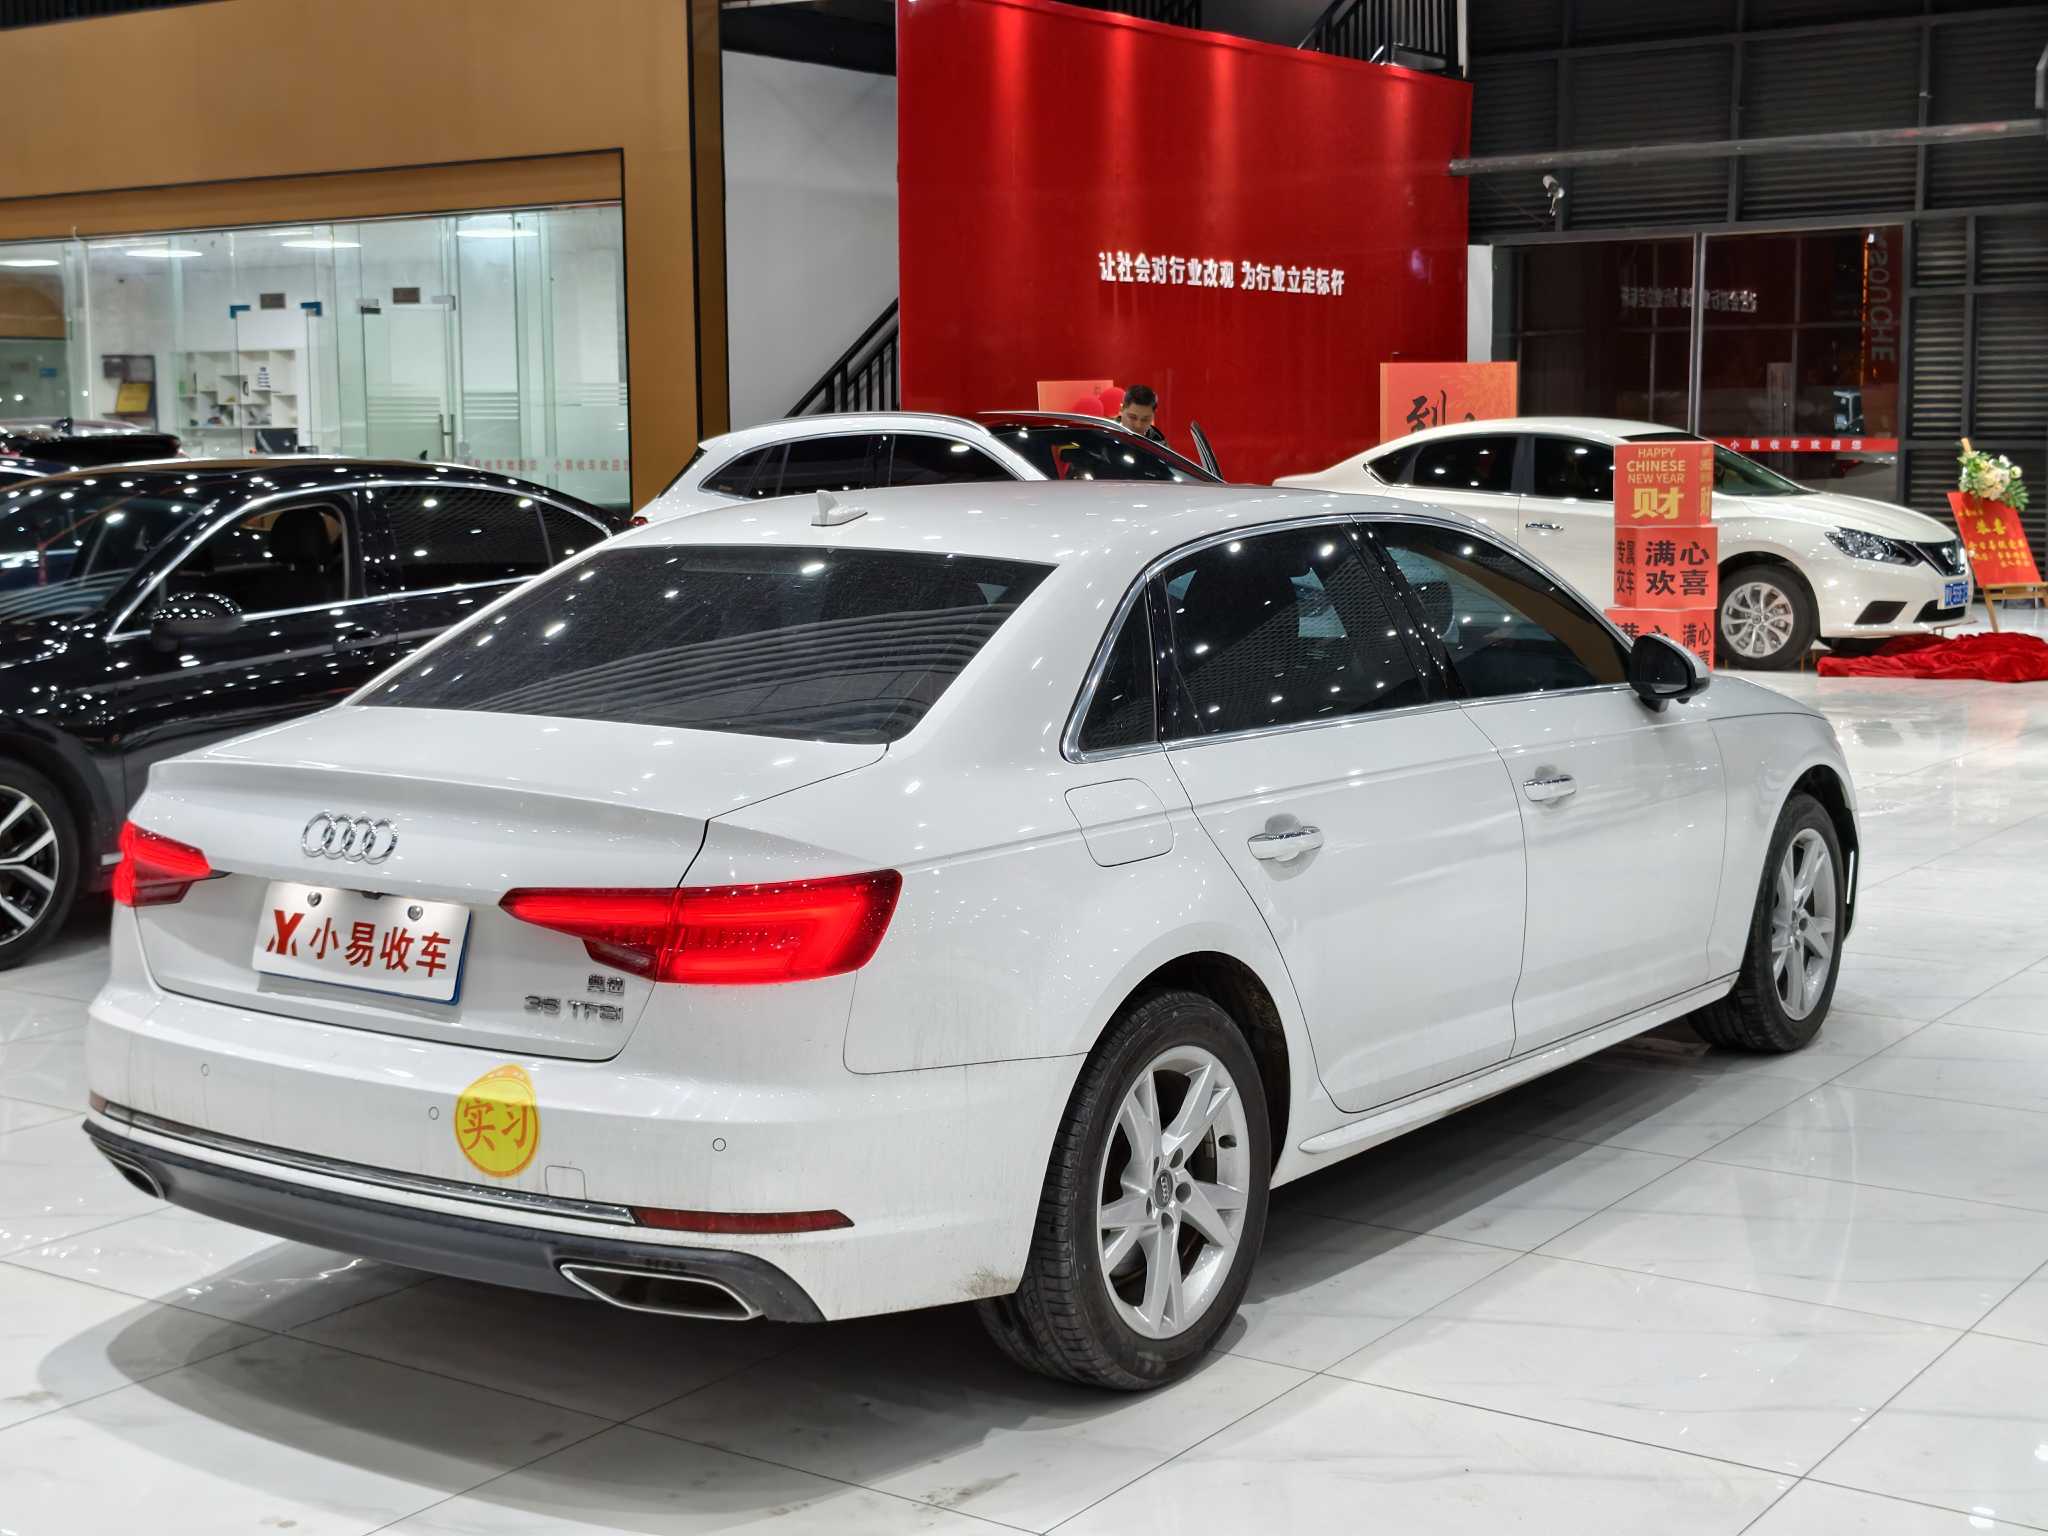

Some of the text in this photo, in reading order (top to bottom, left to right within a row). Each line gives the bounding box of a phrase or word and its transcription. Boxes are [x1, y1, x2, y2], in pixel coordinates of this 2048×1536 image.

[1099, 251, 1345, 295] 让社会对行业改观 为行业立定标杆
[1626, 460, 1686, 472] CHINESE
[1638, 447, 1676, 458] HAPPY
[1627, 472, 1685, 484] NEW YEAR
[1644, 540, 1710, 567] 满心
[1645, 569, 1710, 596] 欢喜
[309, 917, 451, 978] 小易收车
[567, 999, 624, 1022] TFSI
[463, 1097, 528, 1150] 实习
